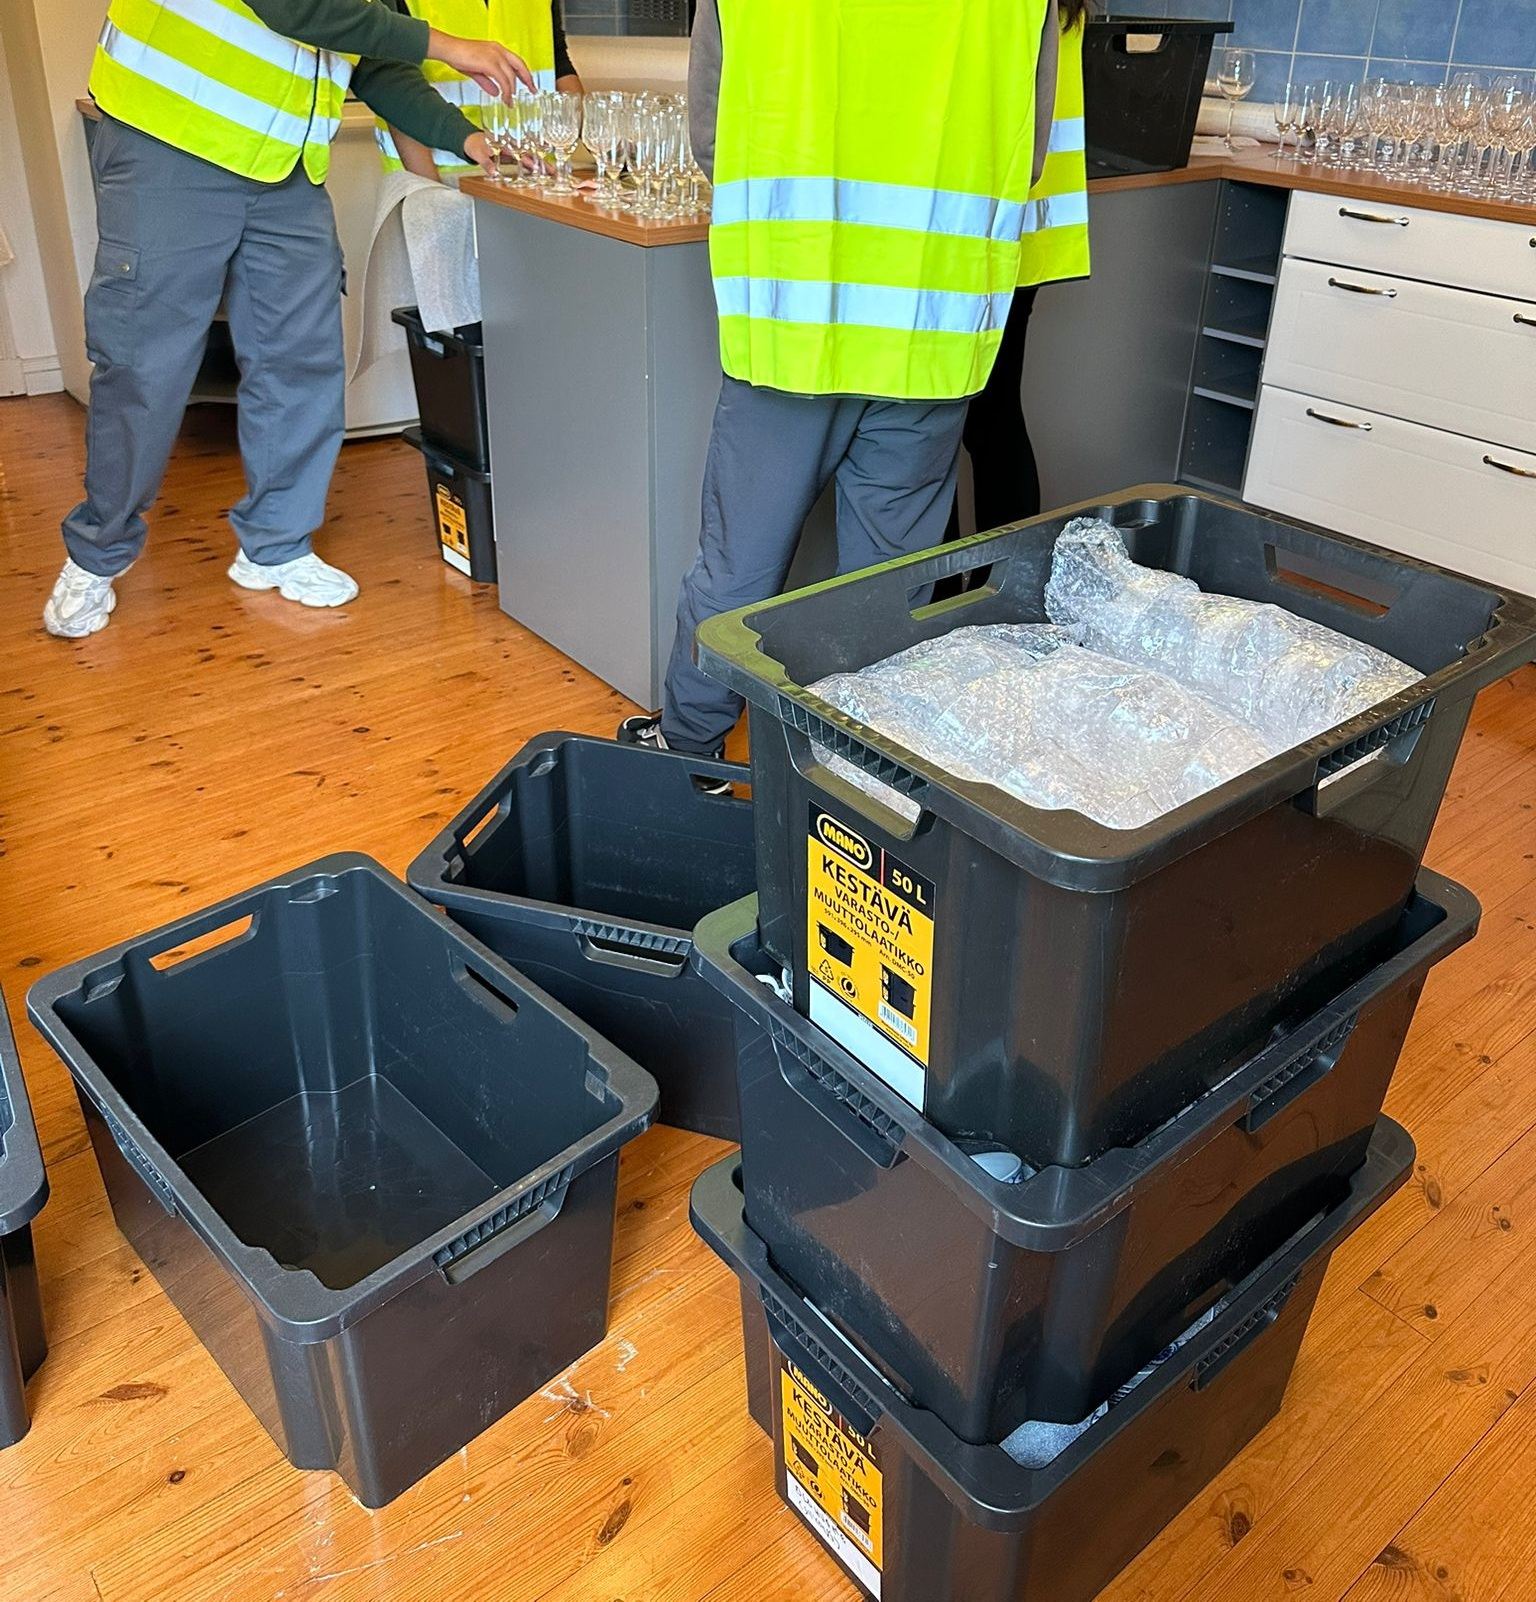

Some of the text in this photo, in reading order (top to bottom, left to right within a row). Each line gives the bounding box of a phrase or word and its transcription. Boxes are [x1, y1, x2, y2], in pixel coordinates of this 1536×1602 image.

[824, 822, 865, 860] MANO
[822, 854, 912, 936] KESTÄVÄ
[835, 886, 899, 941] VARASTO-/
[892, 868, 927, 905] 50 L
[814, 887, 925, 976] MUUTTOLAATIKKO
[793, 1366, 828, 1407] MANO
[787, 1407, 877, 1508] MUUTTOLAATIKKO
[793, 1388, 867, 1477] KESTÄVÄ
[803, 1415, 856, 1474] VARASTO-/
[867, 1443, 876, 1460] L
